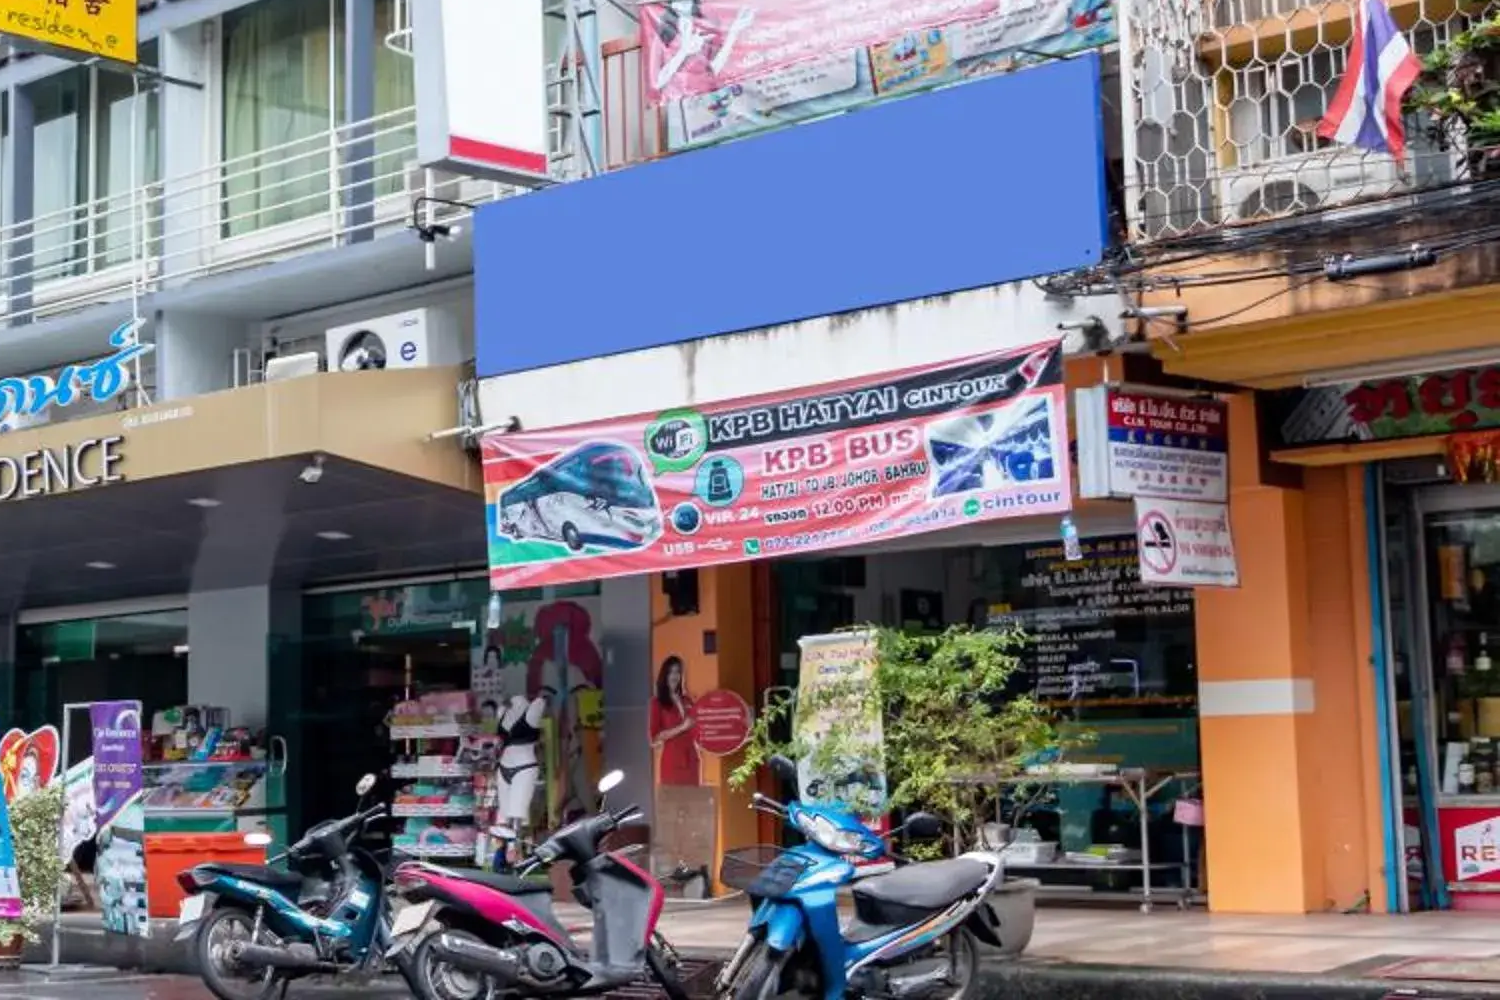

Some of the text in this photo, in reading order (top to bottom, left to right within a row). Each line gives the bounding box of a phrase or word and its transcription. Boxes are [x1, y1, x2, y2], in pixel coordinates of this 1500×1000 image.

[709, 374, 1010, 442] KPB HATYAI CINTOUR
[763, 427, 918, 474] KPB BUS
[859, 495, 884, 509] PM
[982, 490, 1062, 512] cintour
